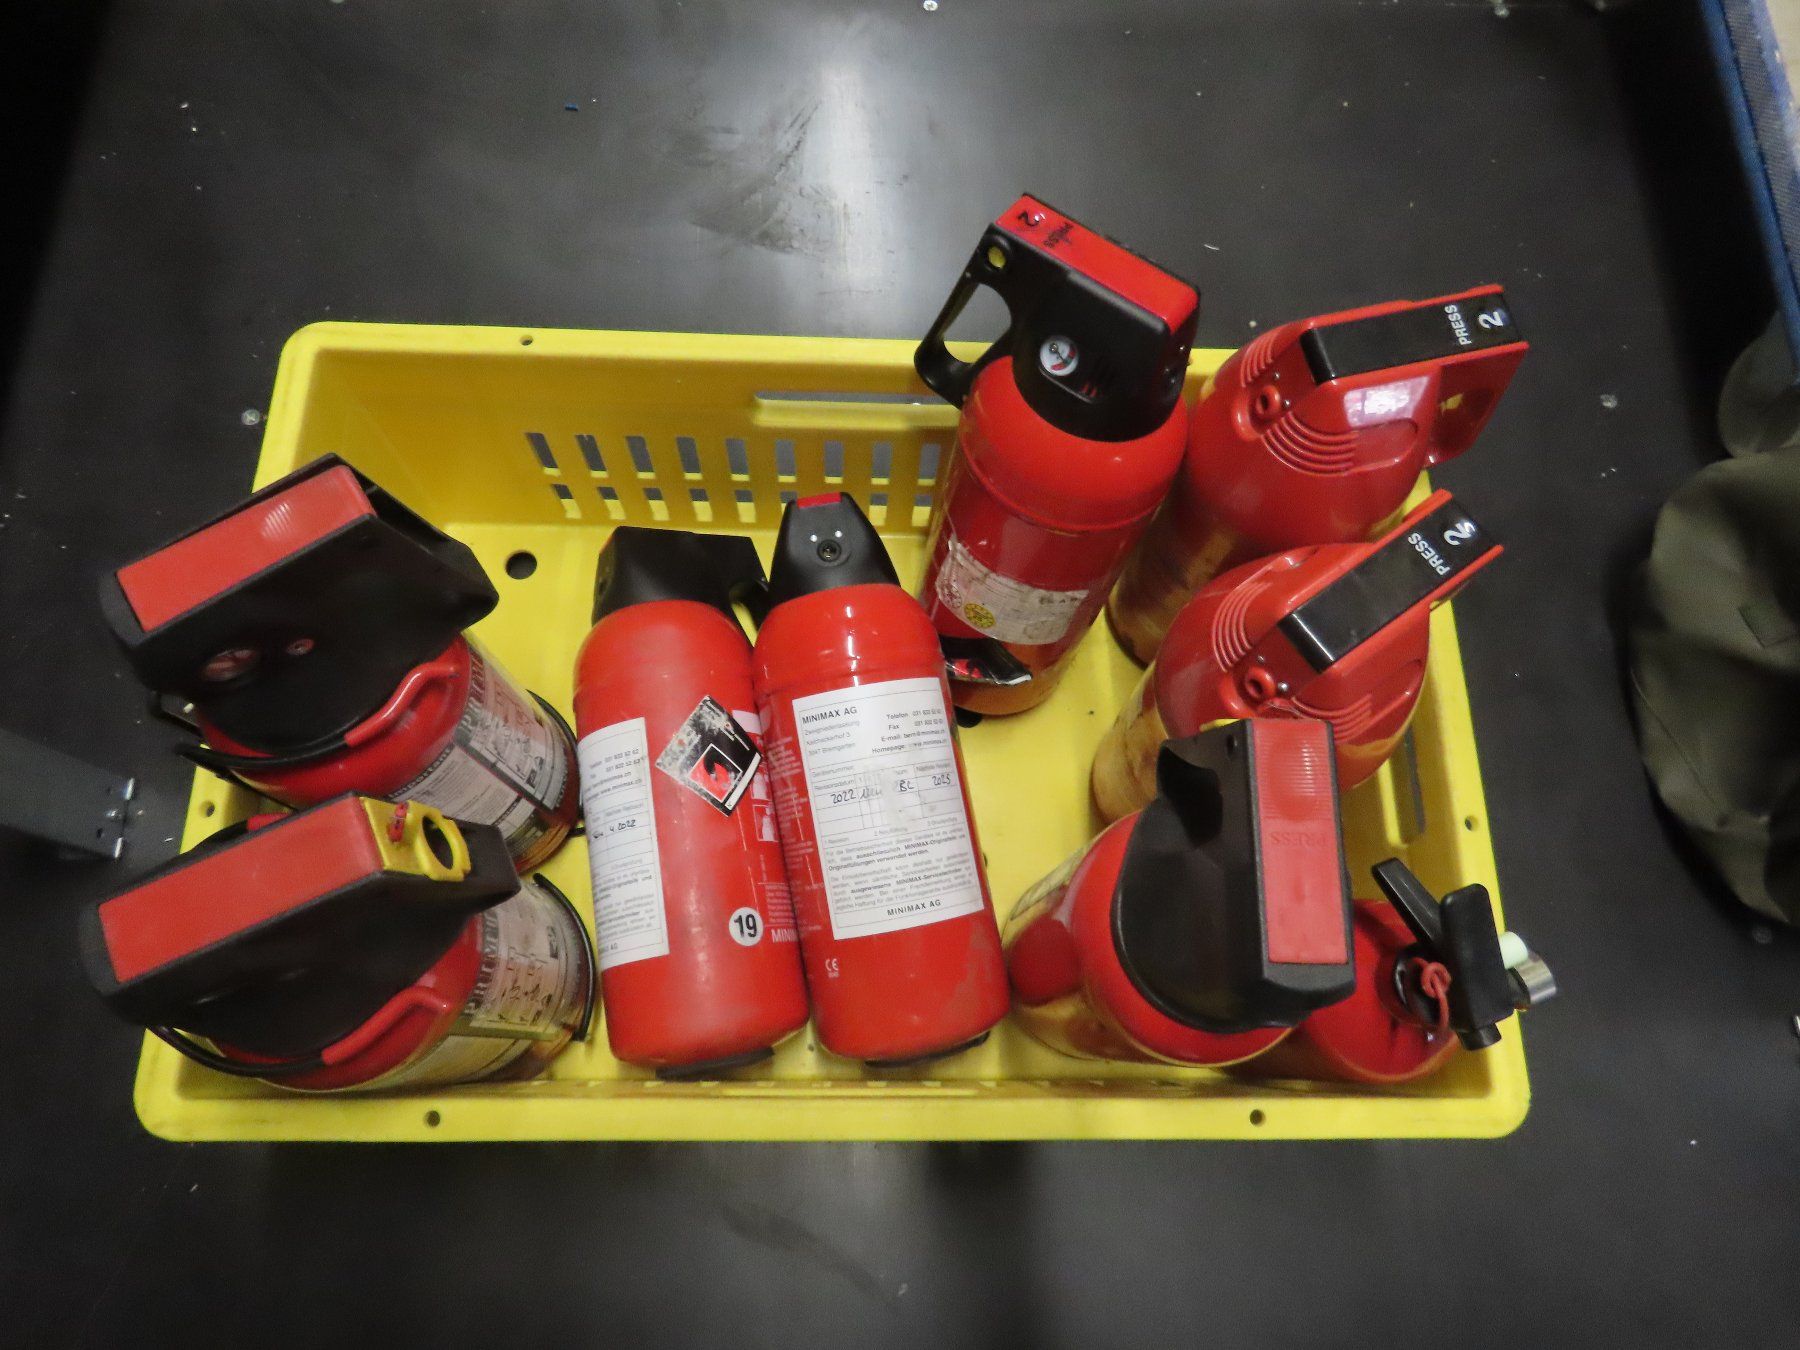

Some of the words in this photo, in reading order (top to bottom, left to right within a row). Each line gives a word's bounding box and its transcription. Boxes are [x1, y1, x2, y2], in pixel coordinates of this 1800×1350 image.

[1444, 304, 1472, 346] PRESS
[1478, 310, 1504, 330] 2
[1443, 519, 1475, 546] 2
[1407, 532, 1450, 576] PRESS
[801, 709, 840, 725] MINIMAX
[843, 706, 858, 716] AG
[830, 789, 856, 804] 2022
[1270, 831, 1327, 848] PRESS
[887, 903, 927, 916] MINIMAX
[929, 899, 942, 908] AG
[733, 913, 758, 938] 19
